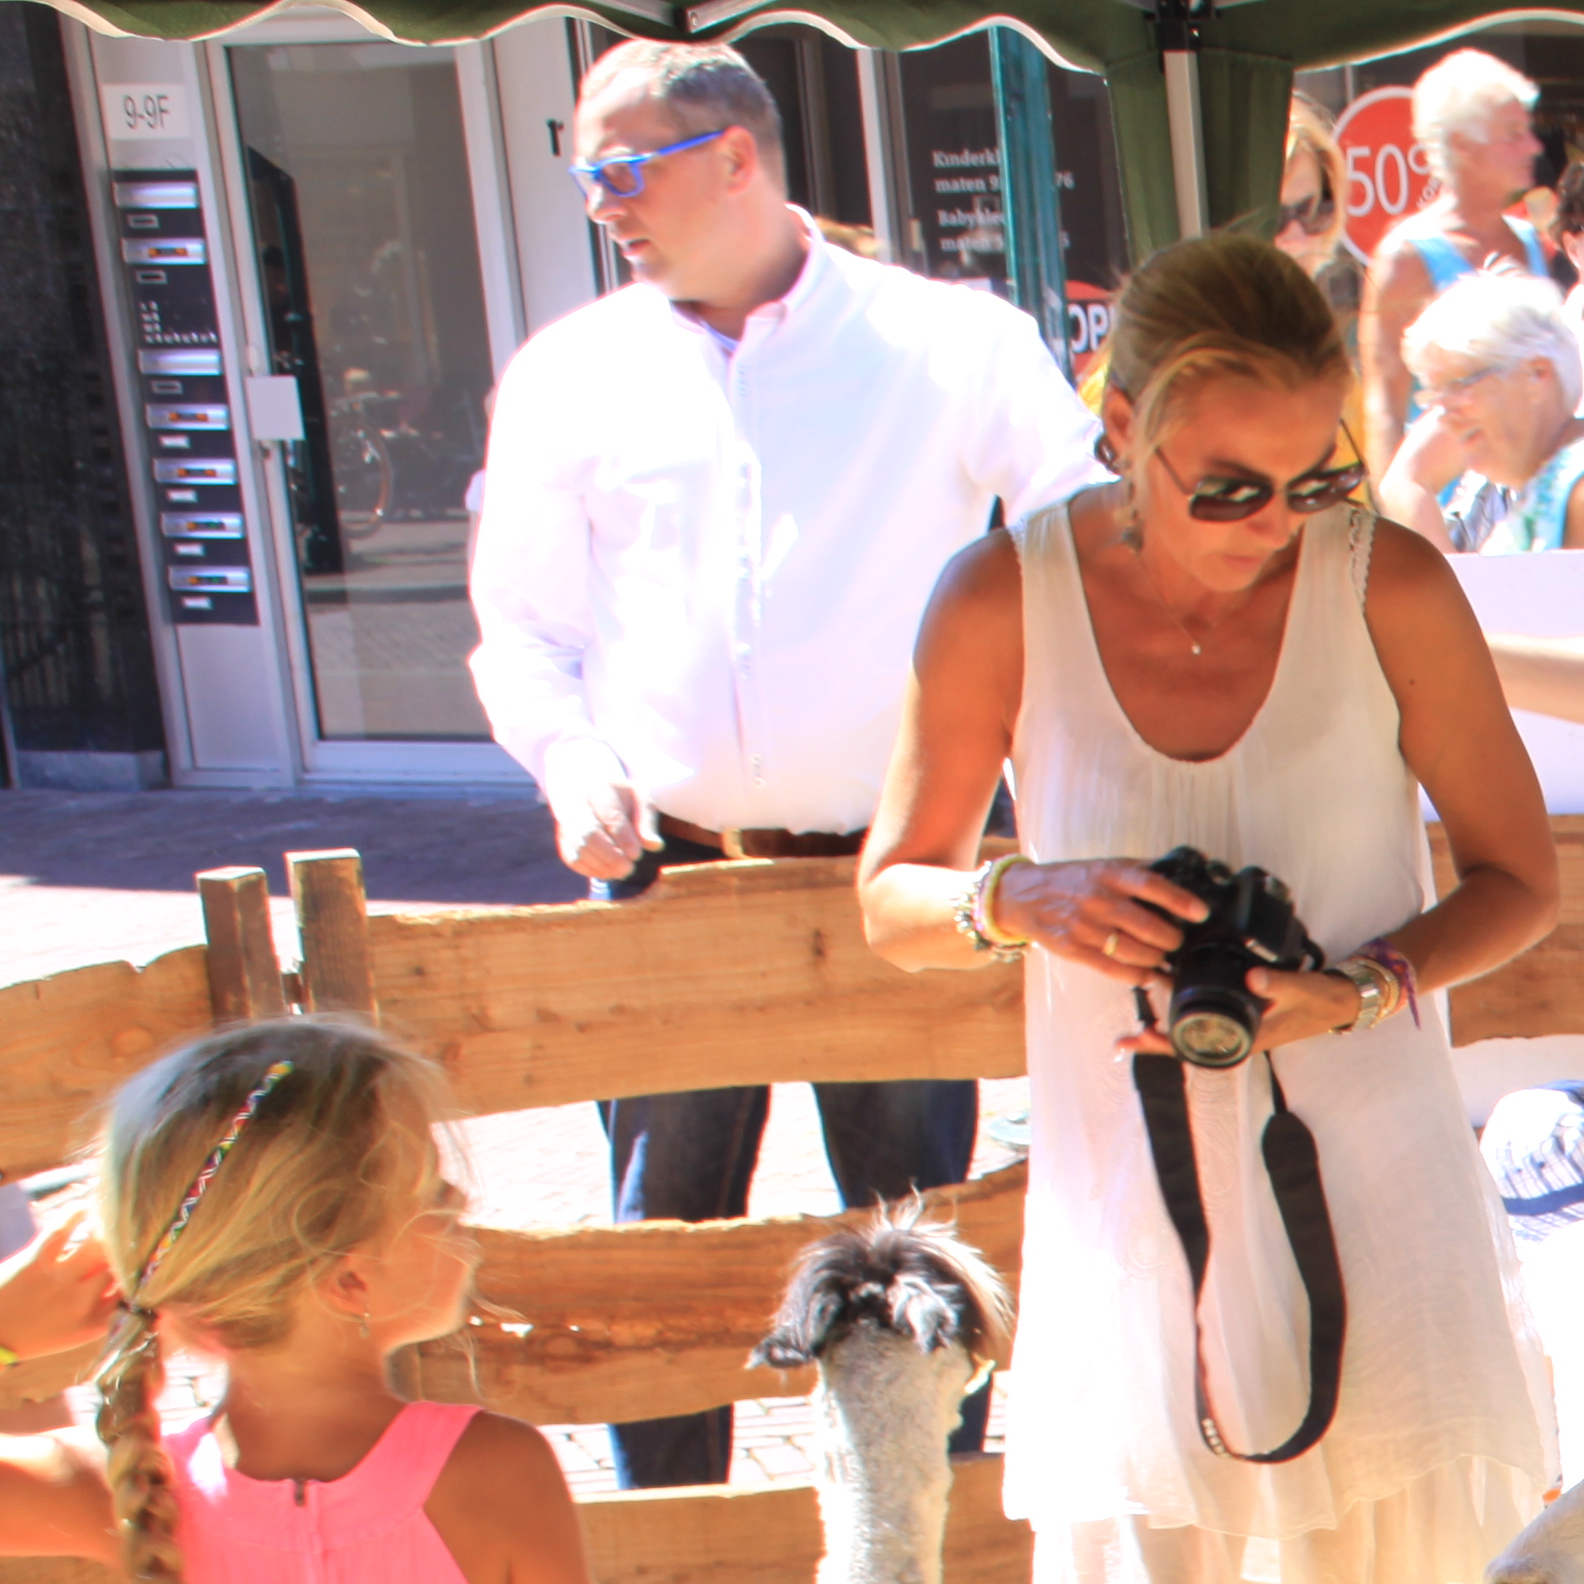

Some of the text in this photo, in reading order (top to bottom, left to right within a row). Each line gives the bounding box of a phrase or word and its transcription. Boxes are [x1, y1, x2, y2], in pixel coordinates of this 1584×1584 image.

[122, 94, 170, 130] 9-9F
[931, 147, 1001, 169] Kinderkl
[933, 175, 987, 193] maten
[1054, 170, 1076, 190] 76
